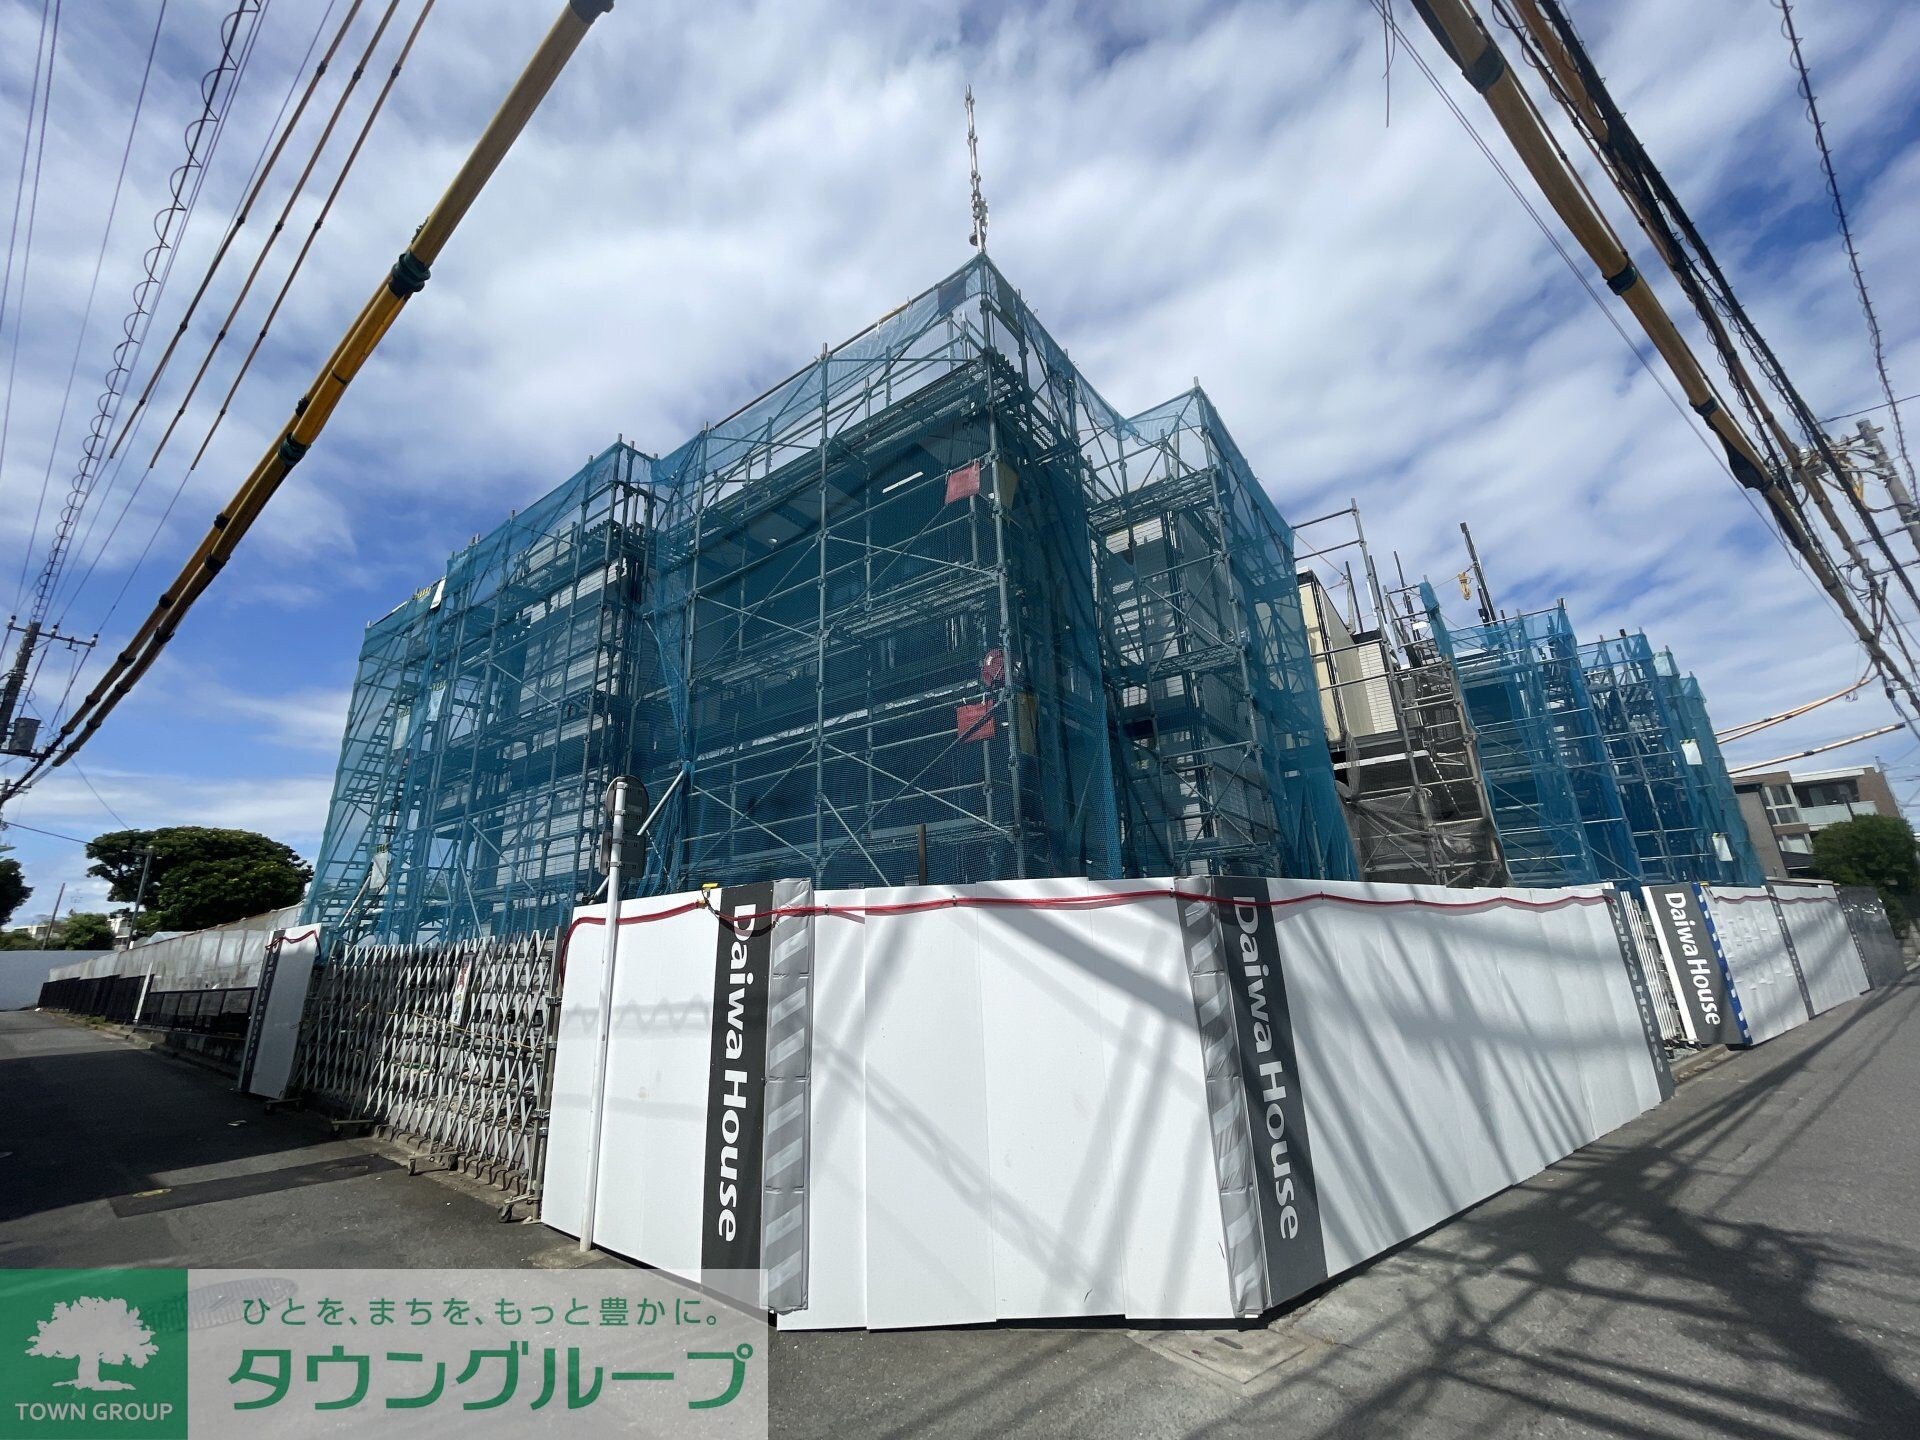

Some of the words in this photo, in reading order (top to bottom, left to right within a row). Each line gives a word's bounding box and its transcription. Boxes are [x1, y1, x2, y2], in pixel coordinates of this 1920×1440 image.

[725, 903, 757, 1060] Daiwa
[1664, 892, 1699, 957] Daiwa
[1686, 959, 1721, 1025] House
[1233, 896, 1274, 1054] Daiwa
[1258, 1060, 1299, 1240] House
[718, 1070, 748, 1242] House
